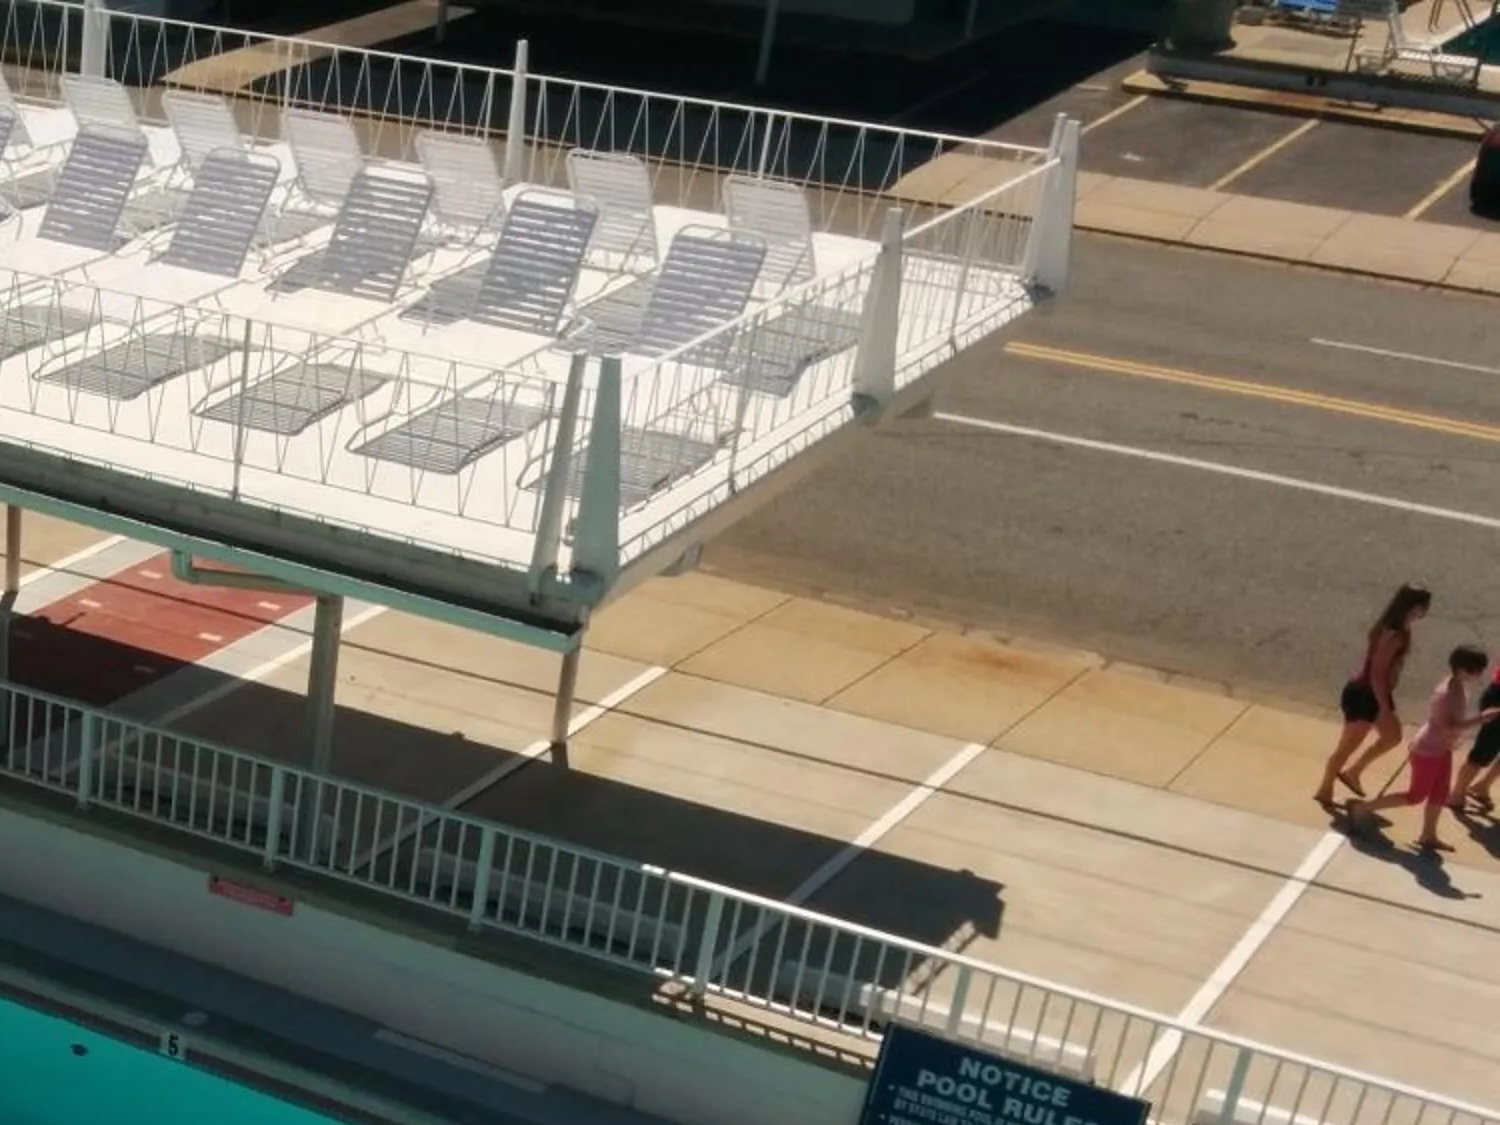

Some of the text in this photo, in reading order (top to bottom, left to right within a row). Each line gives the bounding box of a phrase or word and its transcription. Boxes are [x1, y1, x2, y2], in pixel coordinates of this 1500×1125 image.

[168, 1034, 179, 1057] 5
[915, 1068, 996, 1110] POOL
[957, 1055, 1072, 1108] NOTICE
